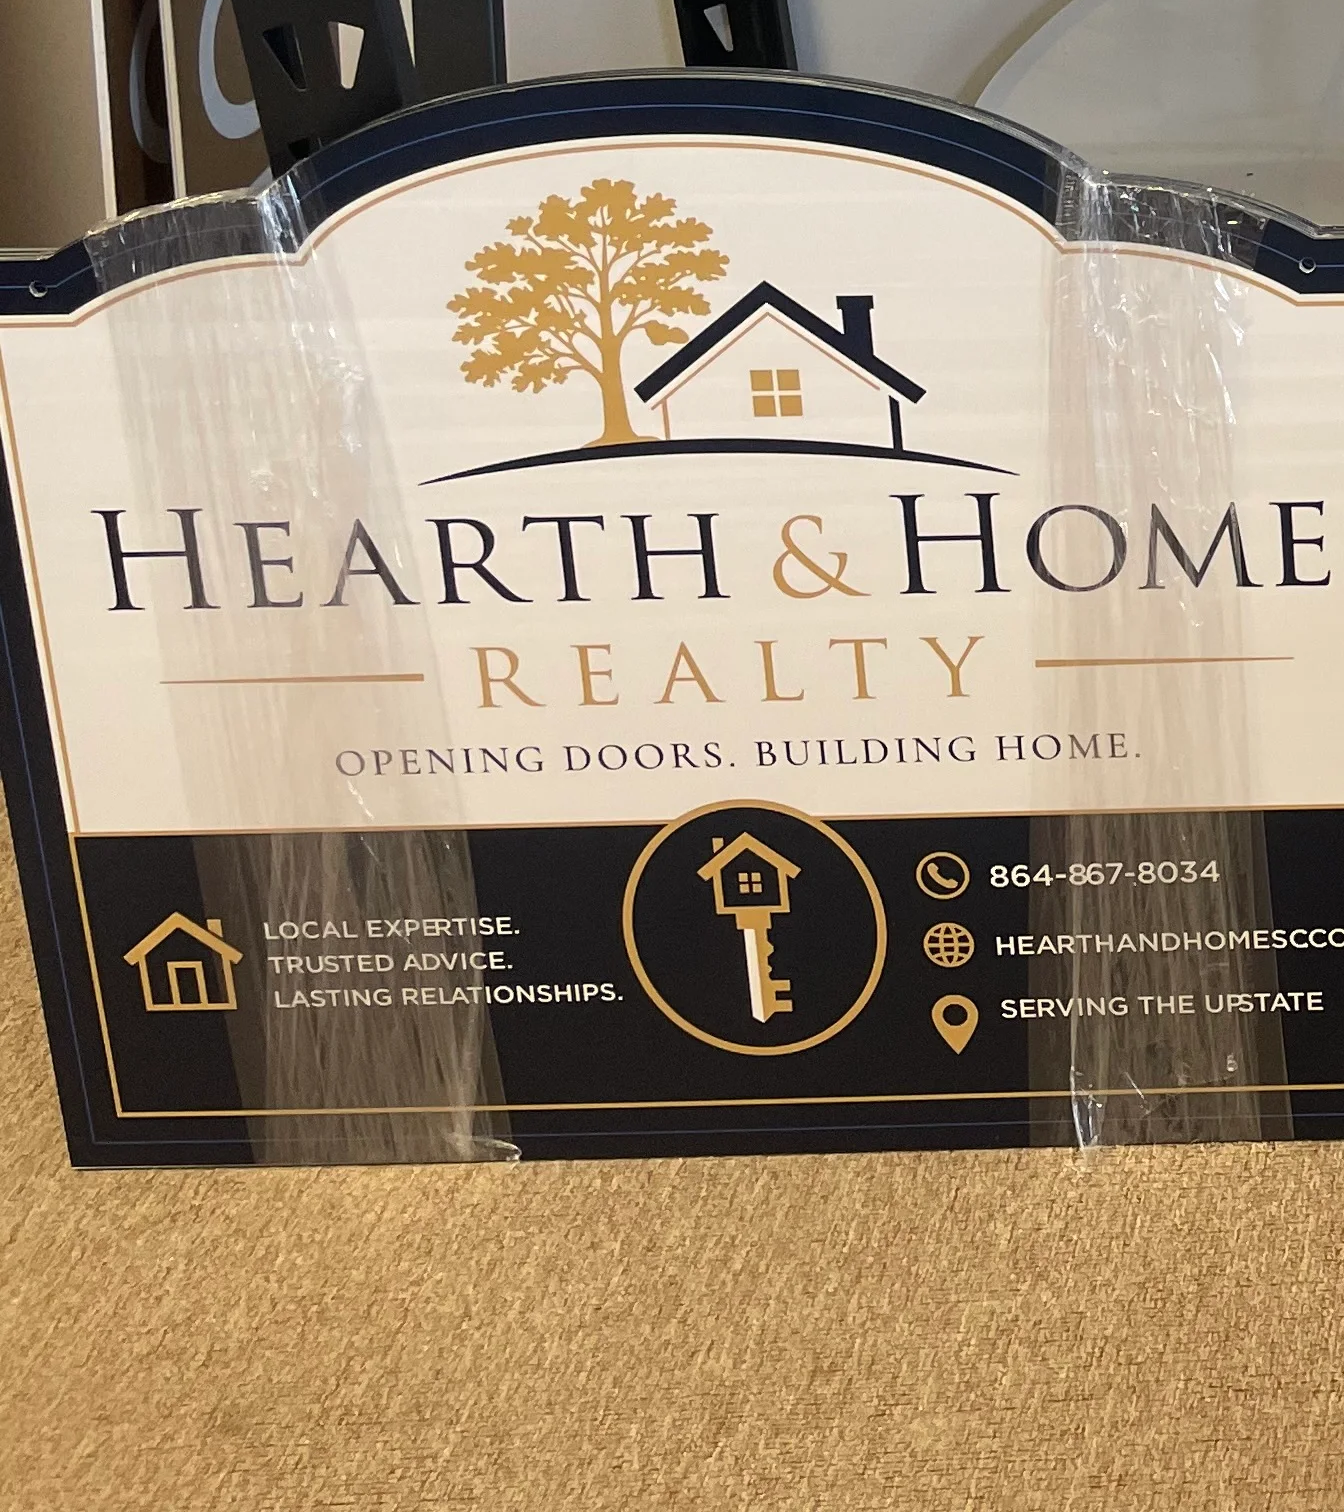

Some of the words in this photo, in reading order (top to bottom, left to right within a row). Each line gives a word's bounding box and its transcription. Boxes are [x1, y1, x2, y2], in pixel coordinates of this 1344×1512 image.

[91, 509, 731, 611] HEARTH
[773, 515, 871, 598] &
[889, 493, 1330, 594] HOME
[470, 636, 984, 708] REALTY
[336, 747, 542, 776] OPENING
[564, 743, 734, 770] DOORS.
[755, 737, 975, 766] BUILDING
[996, 733, 1140, 760] HOME.
[991, 861, 1220, 887] 864-867-8034
[264, 921, 358, 939] LOCAL
[367, 917, 519, 937] EXPERTISE.
[268, 955, 394, 973] TRUSTED
[404, 952, 512, 971] ADVICE.
[275, 989, 392, 1008] LASTING
[402, 984, 622, 1005] RELATIONSHIPS.
[1002, 997, 1128, 1018] SERVING
[1138, 995, 1195, 1014] THE
[1205, 992, 1323, 1013] UPSTATE
